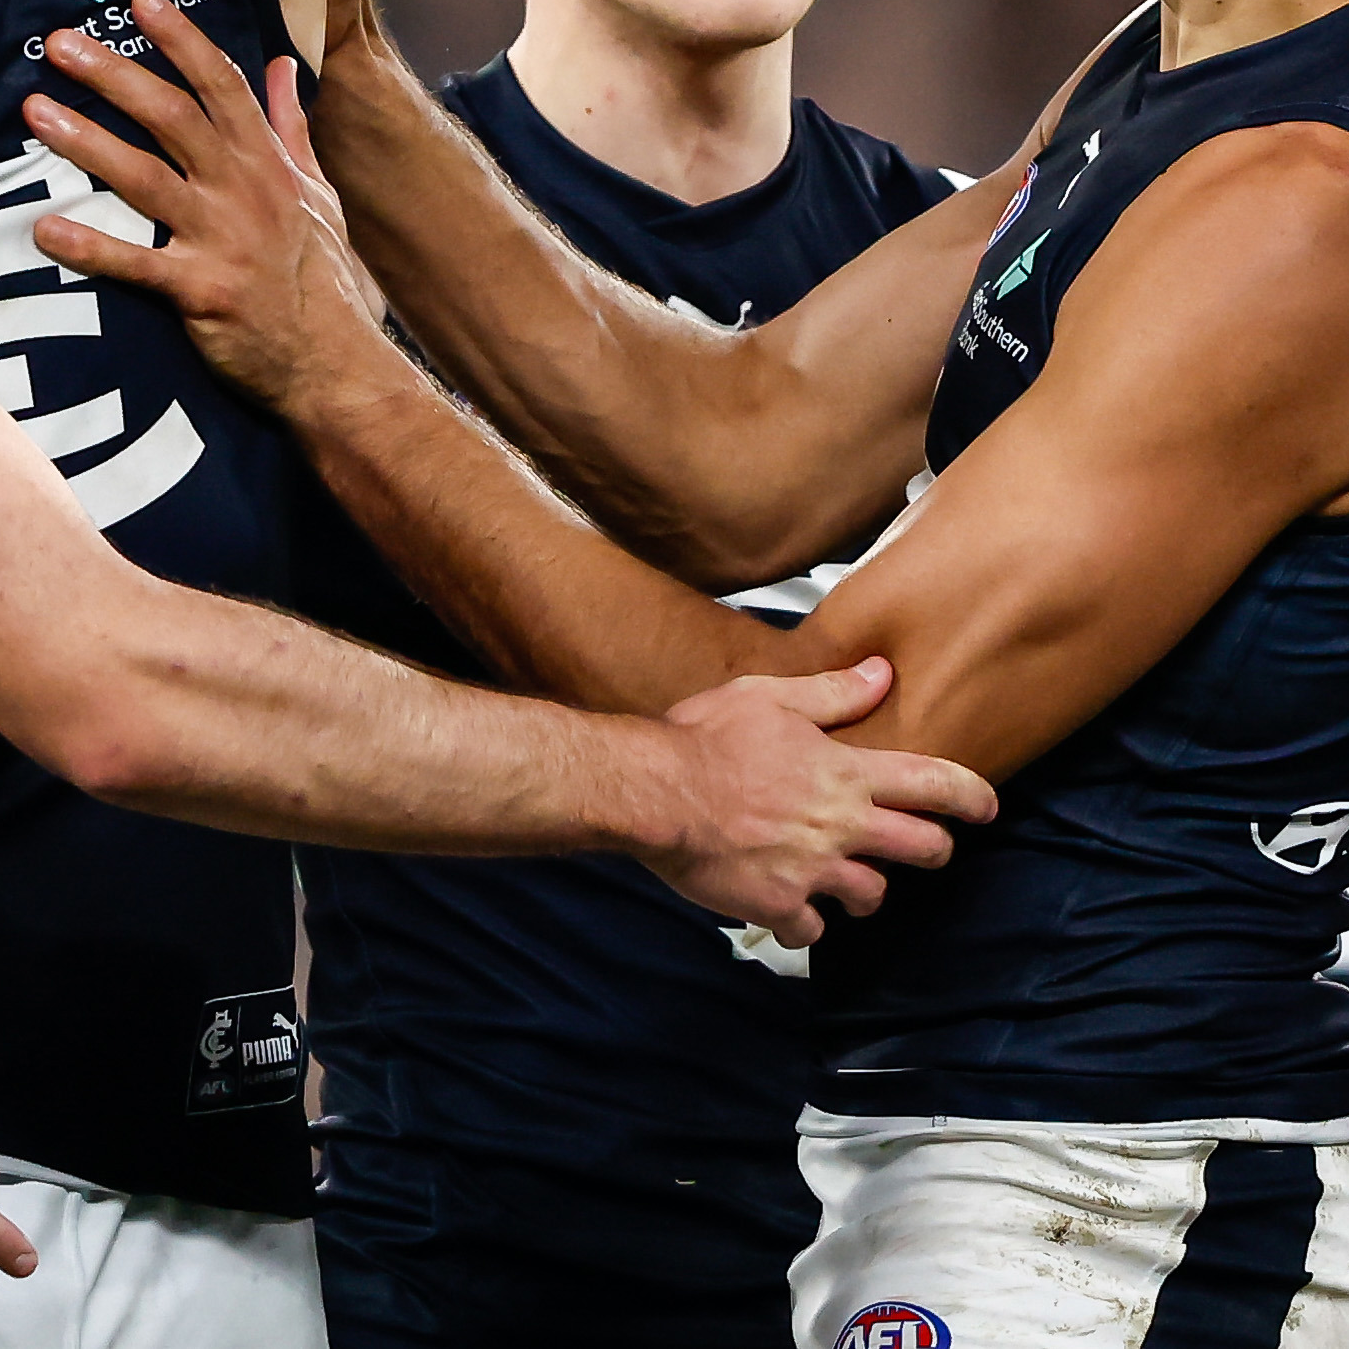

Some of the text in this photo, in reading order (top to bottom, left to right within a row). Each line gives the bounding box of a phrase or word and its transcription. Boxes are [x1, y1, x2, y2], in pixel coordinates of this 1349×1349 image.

[24, 17, 101, 60] Gat
[101, 35, 153, 57] Ban
[242, 1036, 292, 1067] PUMA
